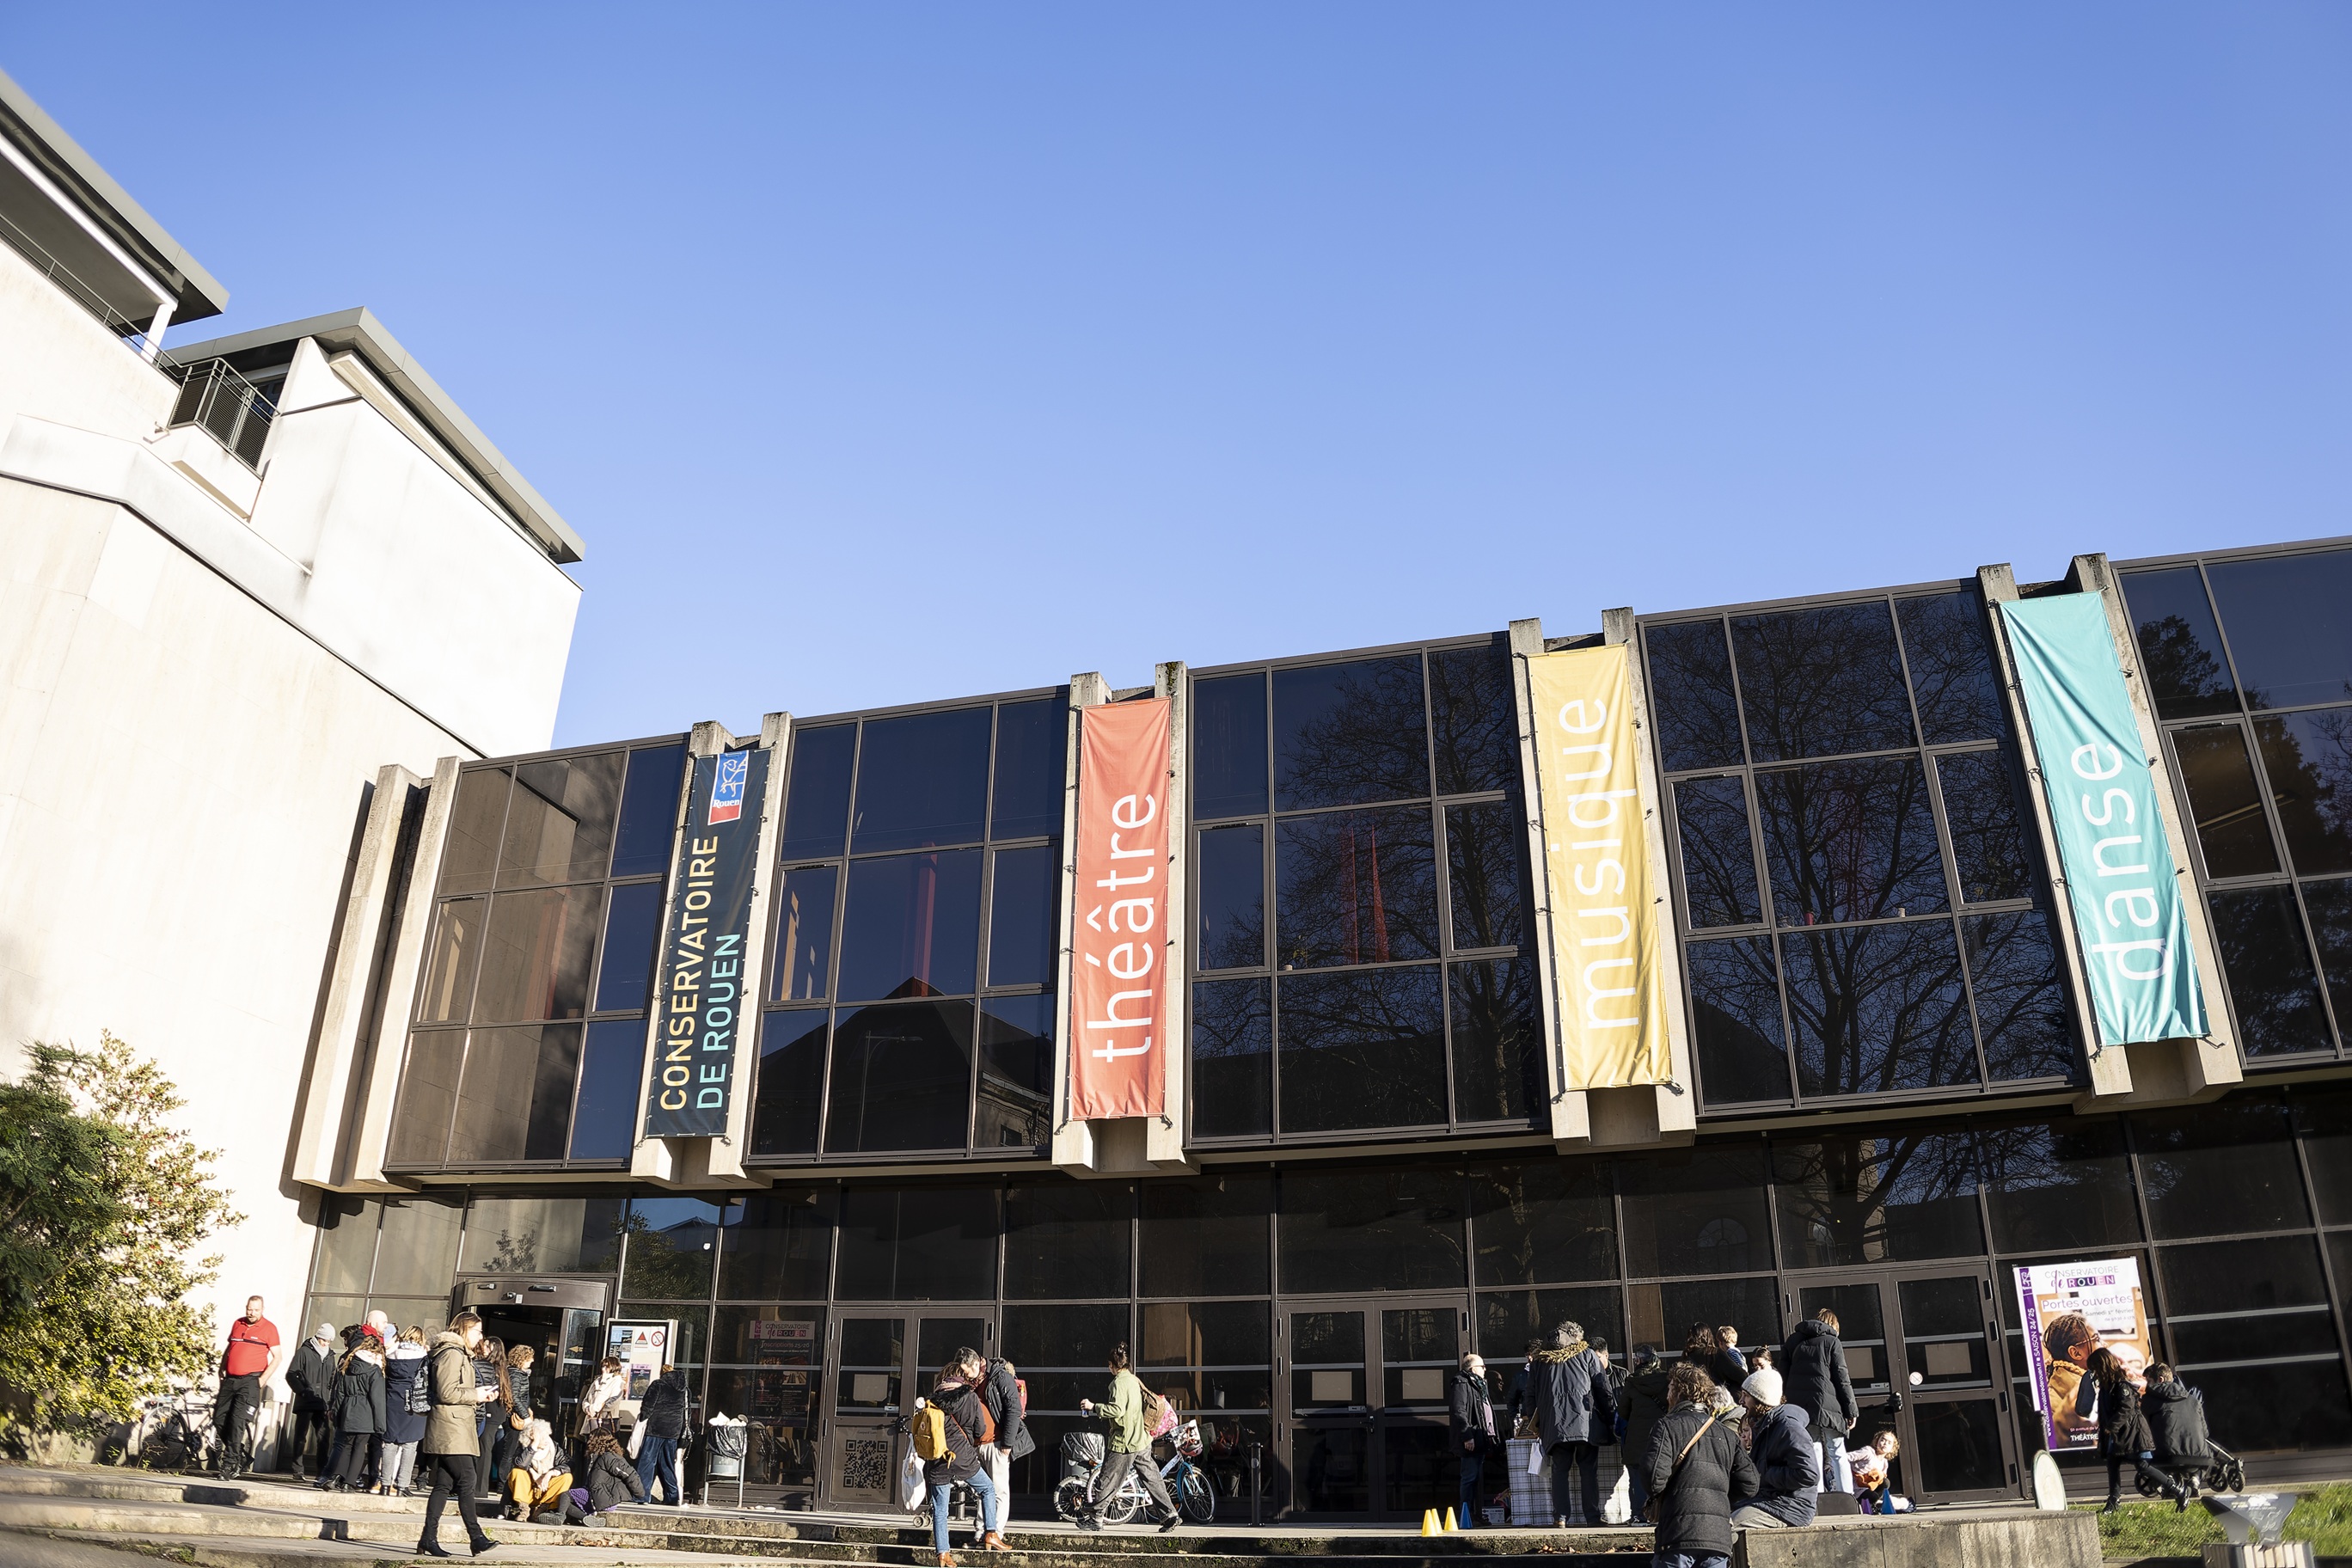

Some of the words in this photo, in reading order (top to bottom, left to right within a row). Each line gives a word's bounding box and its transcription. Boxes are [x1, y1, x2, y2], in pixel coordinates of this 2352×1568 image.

[713, 799, 740, 809] Rouen
[1550, 697, 1639, 1029] musique
[2071, 743, 2171, 981] danse
[1085, 793, 1156, 1063] théâtre
[659, 836, 719, 1111] CONSERVATOIRE
[703, 934, 741, 1051] ROUEN
[696, 1063, 726, 1109] DE
[2044, 1265, 2119, 1279] CONSERVATOIRE
[2050, 1270, 2064, 1293] de
[2067, 1275, 2116, 1288] ROUEN
[2043, 1299, 2079, 1310] Portes
[2082, 1295, 2133, 1307] ouvertes
[2027, 1308, 2037, 1330] 24/25
[760, 1340, 793, 1349] Inscriptions
[2031, 1332, 2041, 1357] SAISON
[2070, 1433, 2099, 1442] THÉÂTRE
